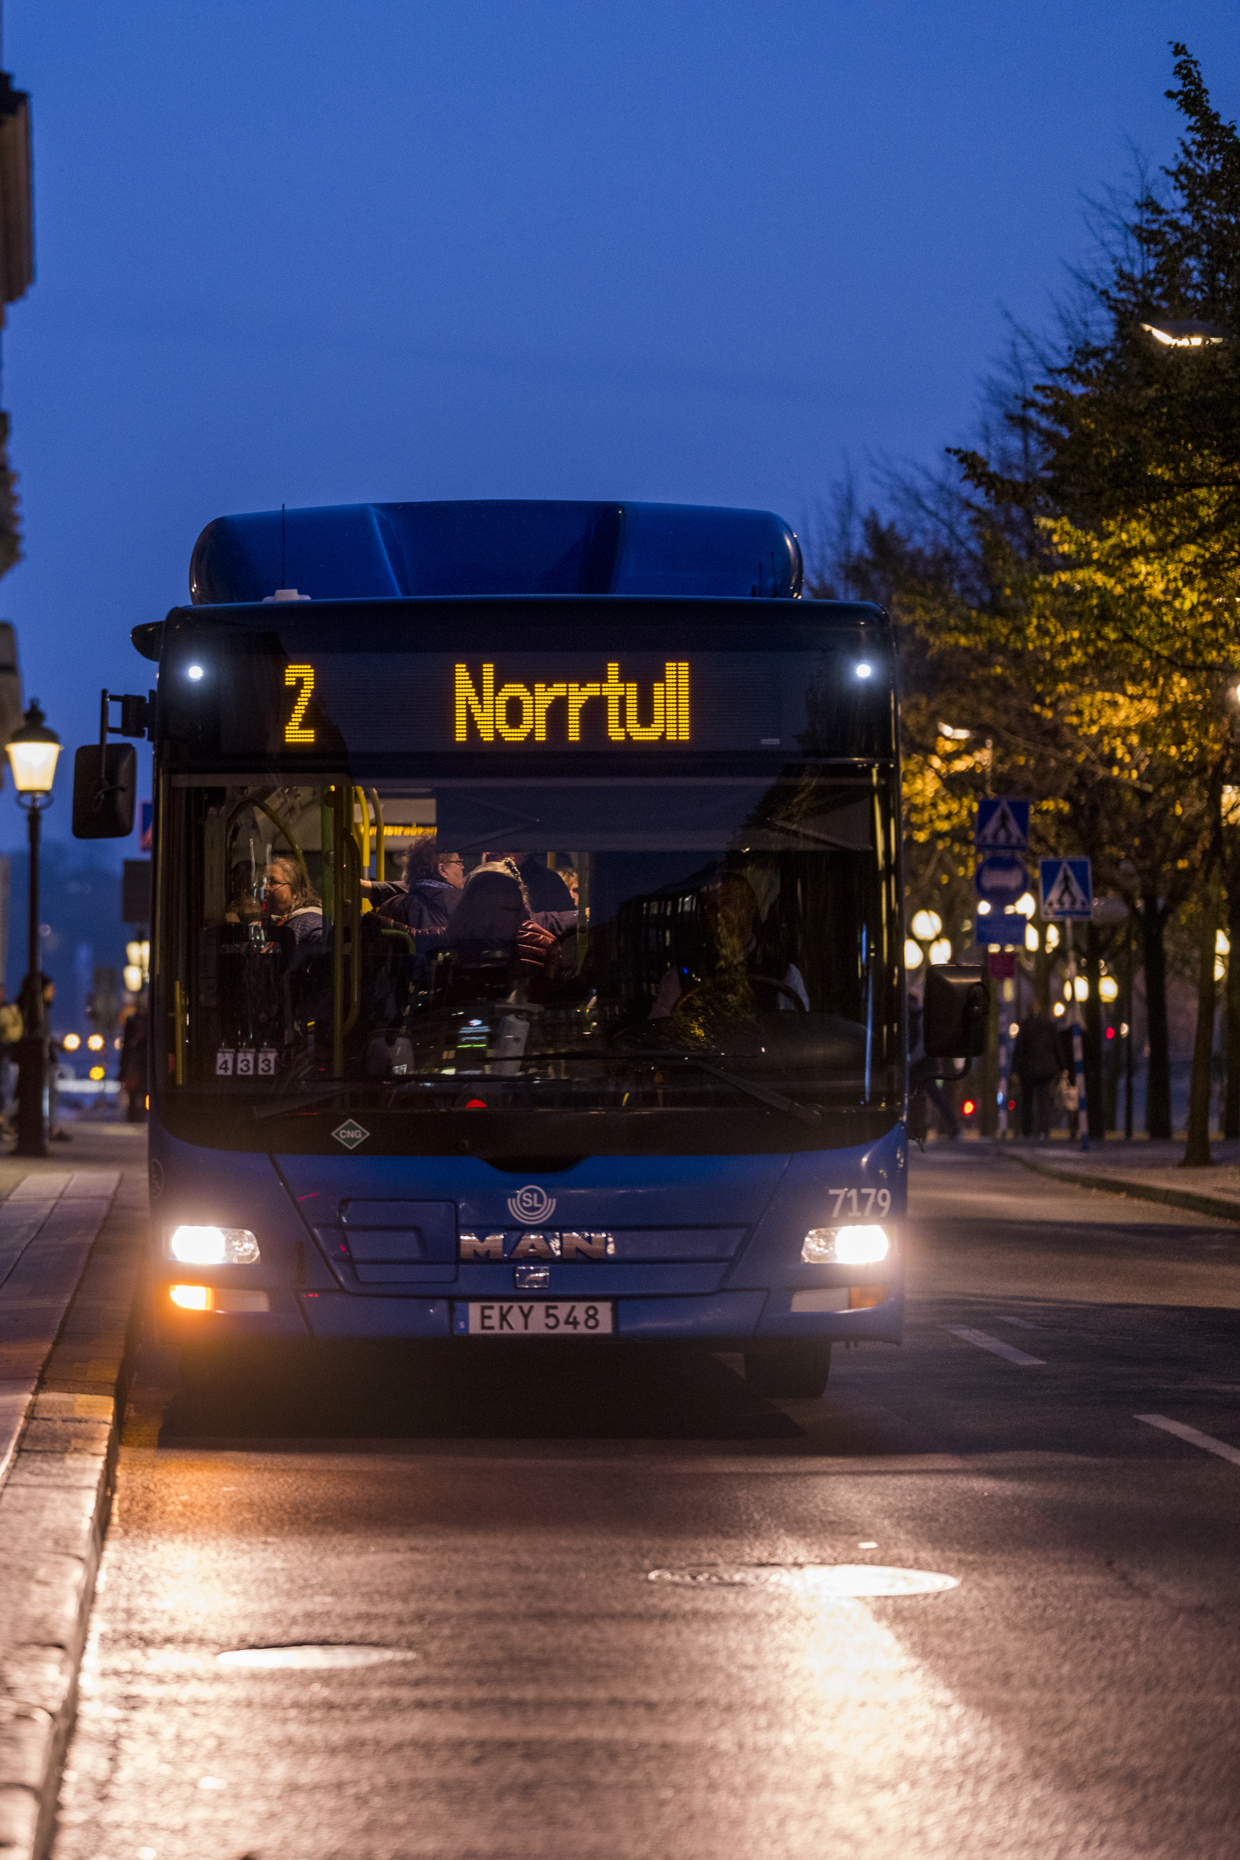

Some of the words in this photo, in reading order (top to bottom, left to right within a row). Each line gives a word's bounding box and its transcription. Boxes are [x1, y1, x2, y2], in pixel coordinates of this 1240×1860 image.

[284, 663, 316, 744] 2
[453, 661, 691, 744] Norrtull
[338, 1129, 363, 1140] CNG
[521, 1191, 543, 1209] SL
[827, 1187, 892, 1218] 7179
[460, 1231, 611, 1260] MAN
[480, 1304, 535, 1331] EKY
[544, 1304, 601, 1331] 548
